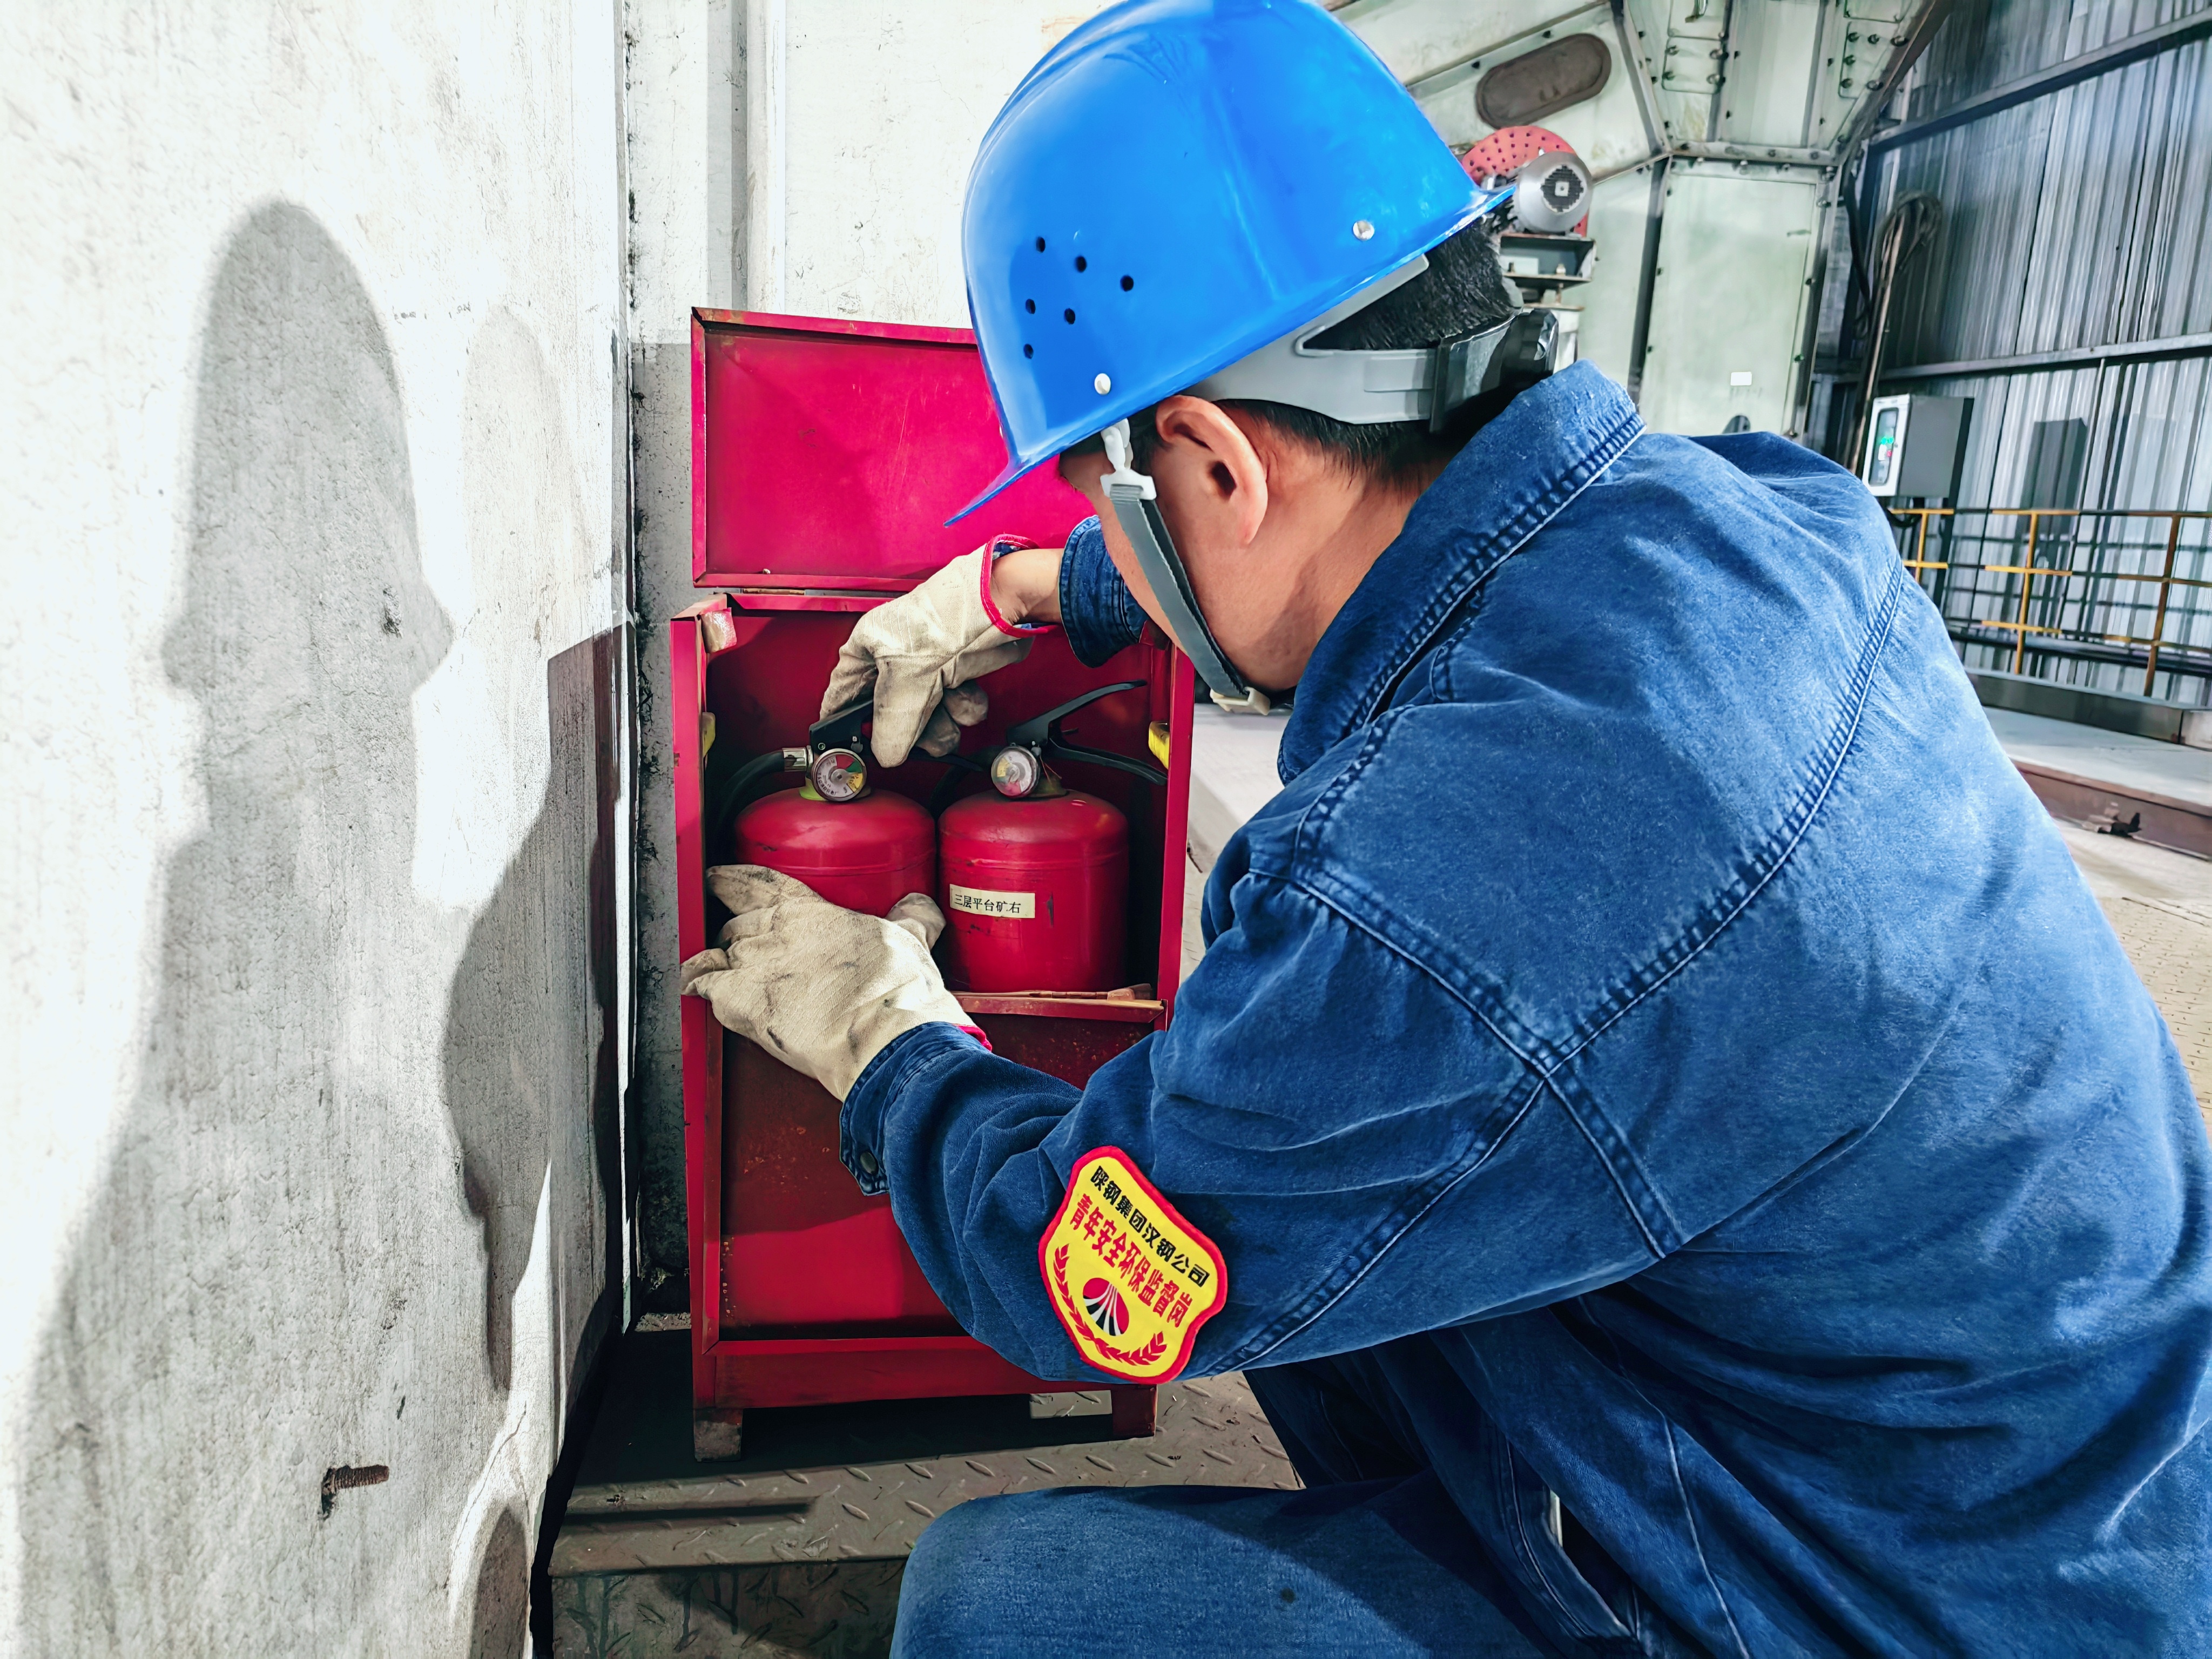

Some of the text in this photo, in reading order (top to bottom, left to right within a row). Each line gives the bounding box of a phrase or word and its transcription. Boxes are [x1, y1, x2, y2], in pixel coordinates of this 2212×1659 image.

[1069, 1193, 1194, 1328] 青年安全环保监督岗
[1090, 1165, 1210, 1287] 陕钢集团汉钢公司
